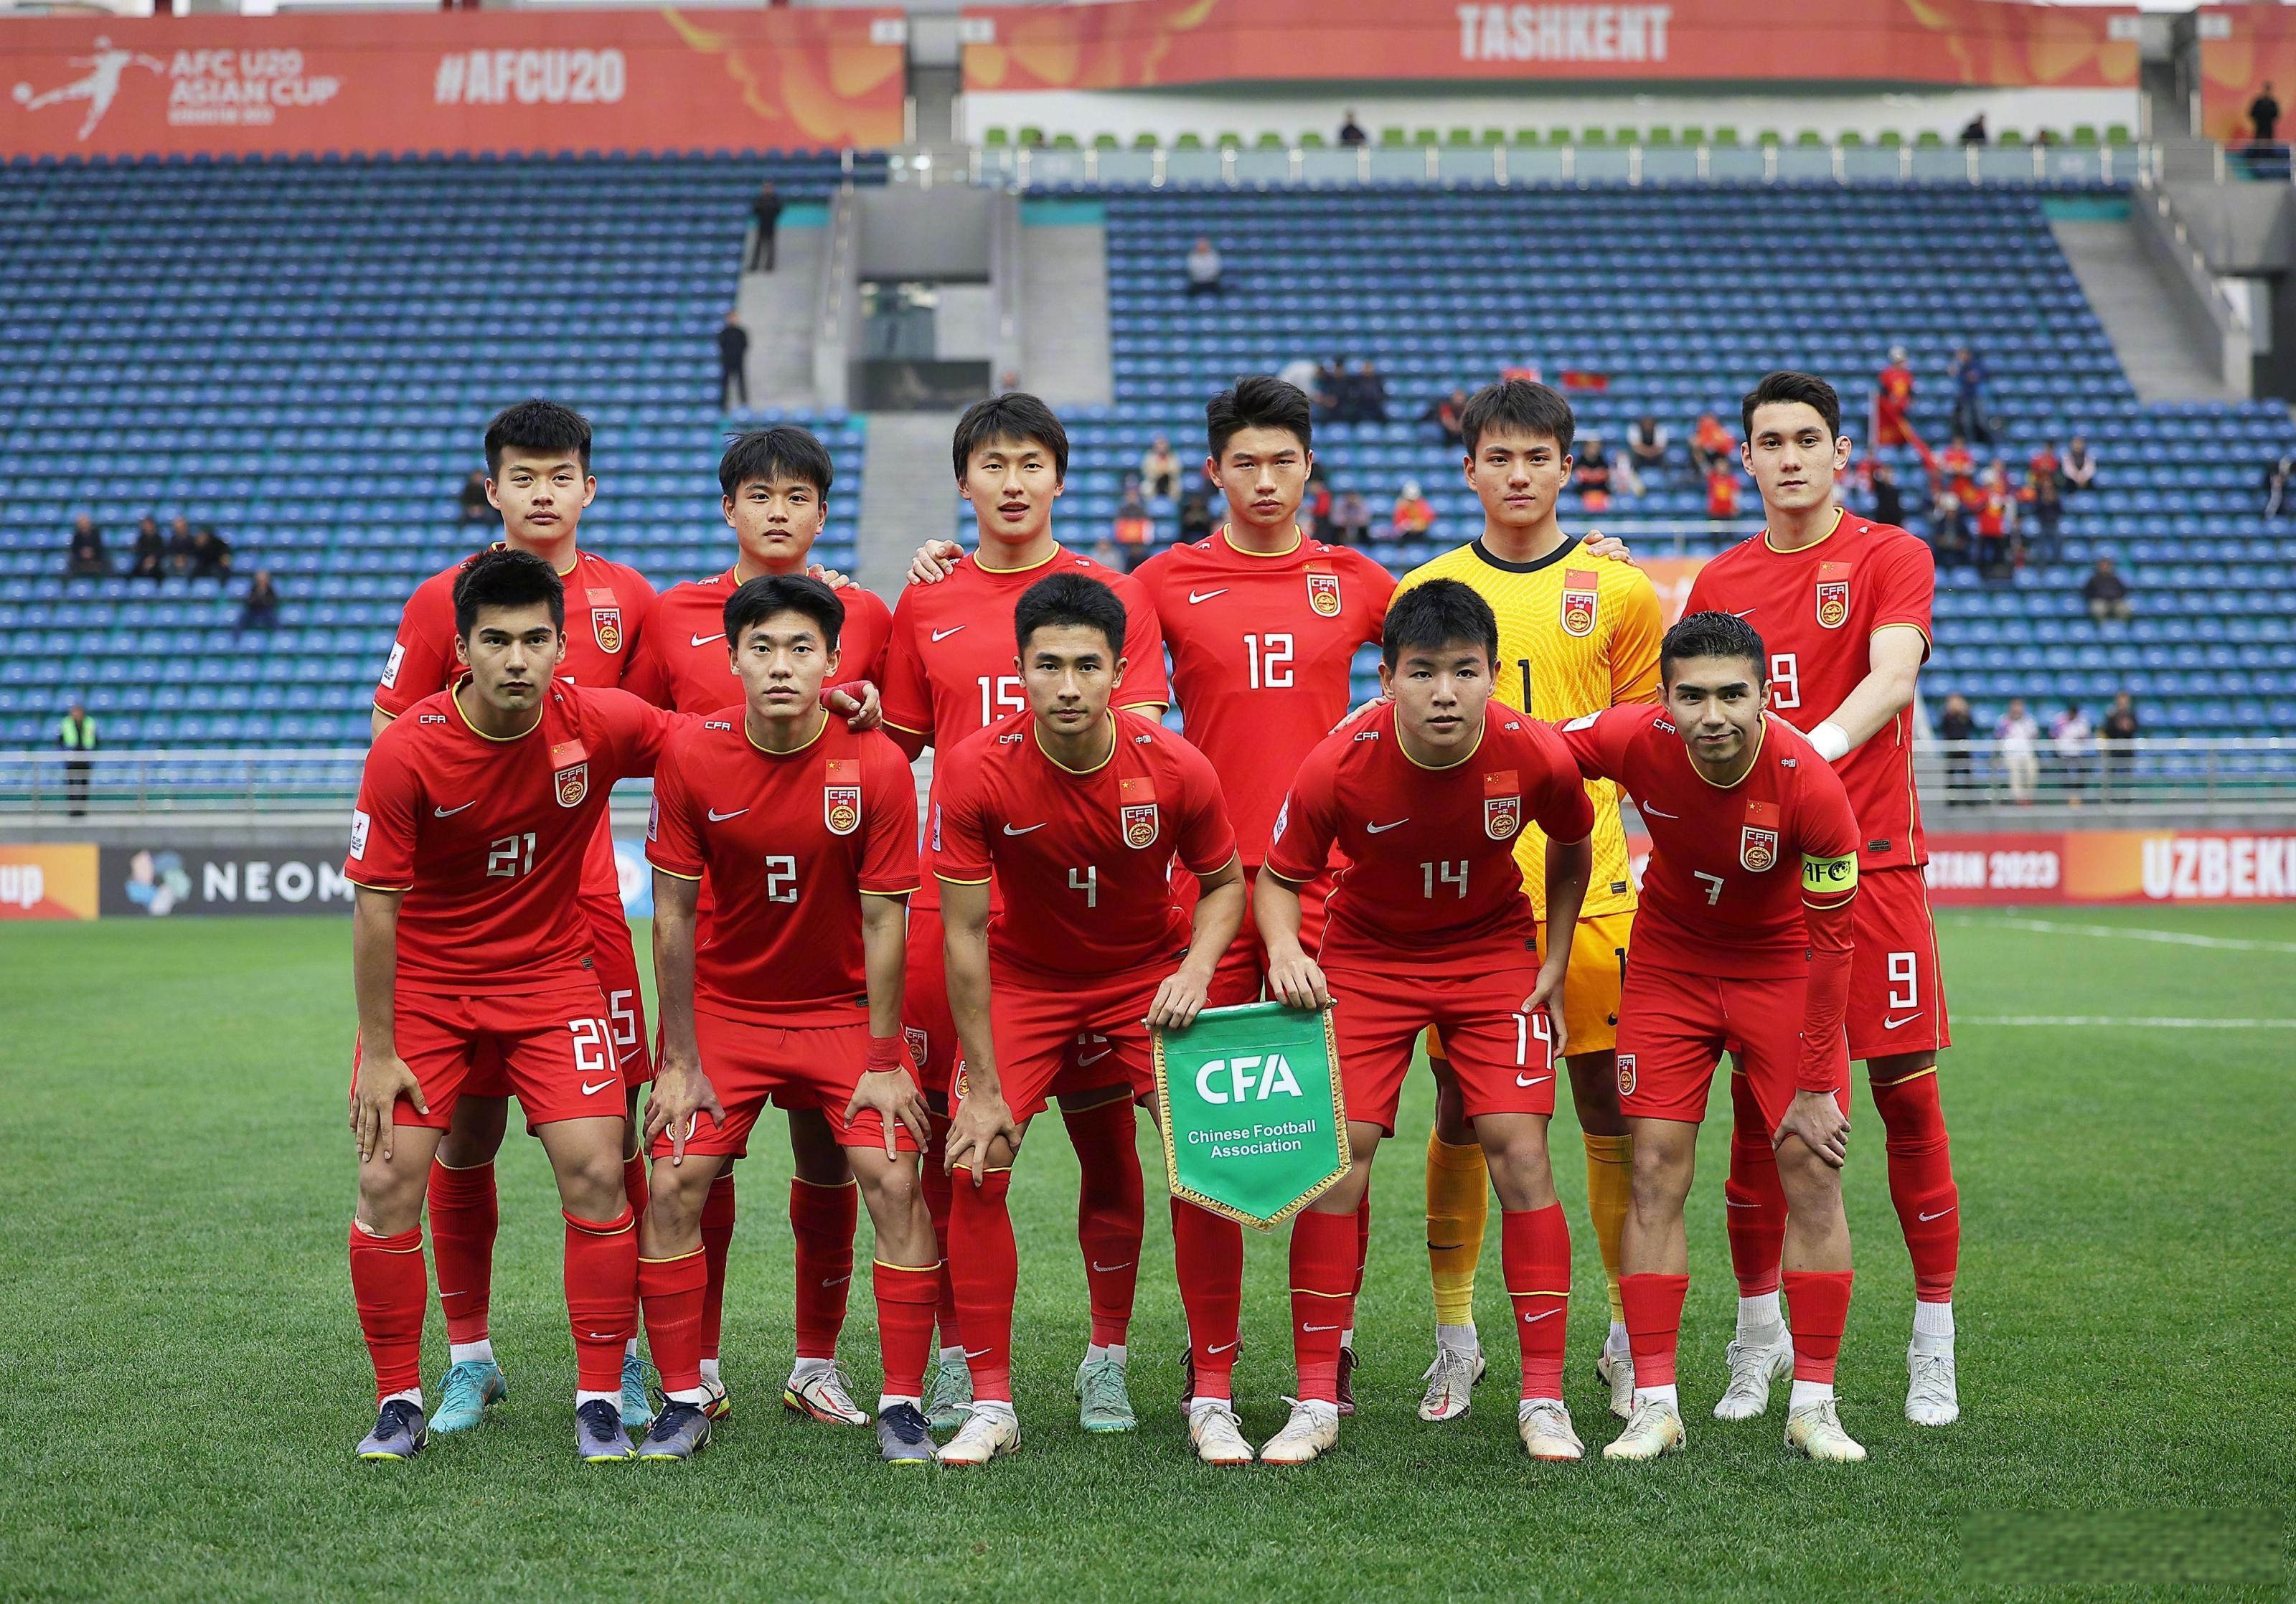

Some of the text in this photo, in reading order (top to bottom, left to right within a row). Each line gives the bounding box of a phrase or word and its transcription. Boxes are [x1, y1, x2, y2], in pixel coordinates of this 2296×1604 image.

[1457, 5, 1671, 60] TASHKENT
[170, 48, 303, 77] AFC U20
[435, 48, 626, 103] #AFCU20
[169, 76, 339, 105] ASIAN CUP
[1312, 579, 1335, 588] CFA
[1822, 586, 1845, 596] CFA
[1568, 595, 1592, 604] CFA
[596, 613, 617, 621] CFA
[1243, 633, 1294, 689] 12
[1518, 659, 1531, 713] 1
[1772, 654, 1800, 709] 9
[977, 676, 1025, 727] 15
[420, 714, 446, 724] CFA
[705, 720, 731, 732] CFA
[1505, 722, 1520, 730] 中国
[1653, 719, 1676, 735] CFA
[999, 734, 1022, 744] CFA
[1135, 735, 1152, 745] 中国
[1354, 731, 1378, 741] CFA
[560, 768, 583, 780] CFA
[1781, 759, 1796, 768] 中国
[829, 791, 856, 800] CFA
[1490, 801, 1515, 810] CFA
[1126, 808, 1154, 818] CFA
[1747, 831, 1774, 842] CFA
[486, 832, 536, 877] 21
[203, 861, 356, 902] NEOM
[766, 855, 797, 902] 2
[1420, 860, 1468, 899] 14
[1802, 860, 1850, 883] AFC
[1989, 850, 2060, 889] 2023
[1068, 866, 1096, 907] 4
[1694, 870, 1724, 905] 7
[1888, 952, 1917, 1008] 9
[568, 1018, 616, 1071] 21
[908, 1032, 923, 1040] CFA
[1512, 1013, 1552, 1070] 14
[1195, 1054, 1304, 1104] CFA
[1187, 1119, 1316, 1144] Chinese Football
[1210, 1139, 1302, 1159] Association
